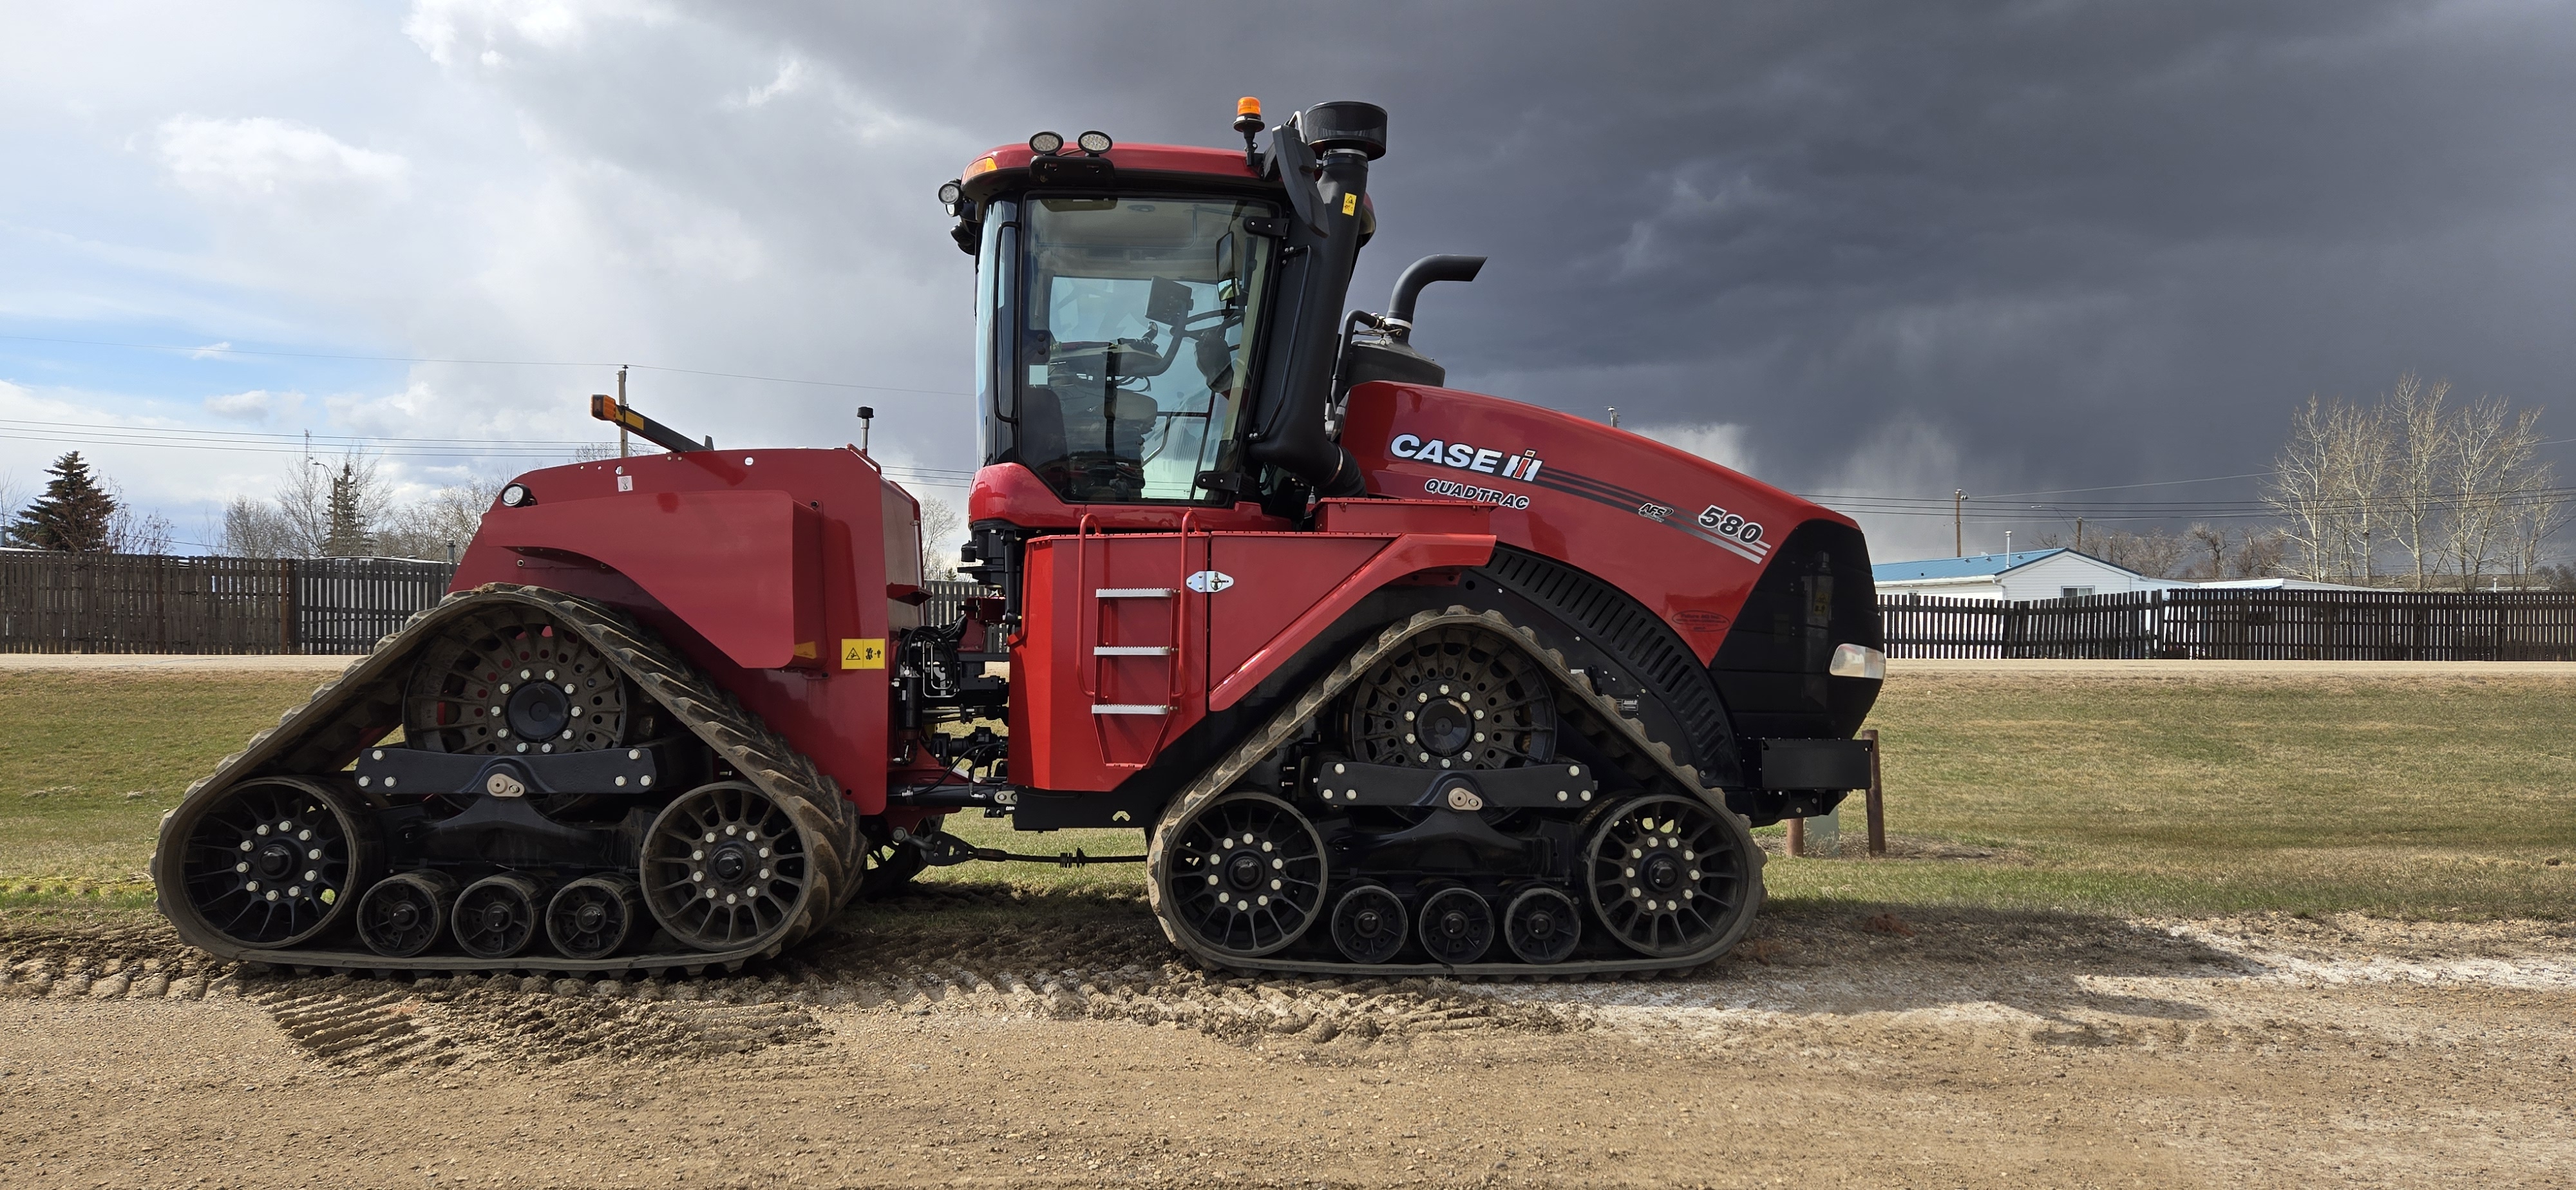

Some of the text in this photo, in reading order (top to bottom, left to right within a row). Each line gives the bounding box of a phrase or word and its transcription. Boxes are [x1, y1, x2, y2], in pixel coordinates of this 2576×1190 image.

[1390, 433, 1543, 482] CASE IH
[1424, 478, 1530, 510] QUADTRAC
[1639, 502, 1667, 516] AFS
[1698, 504, 1763, 545] 580
